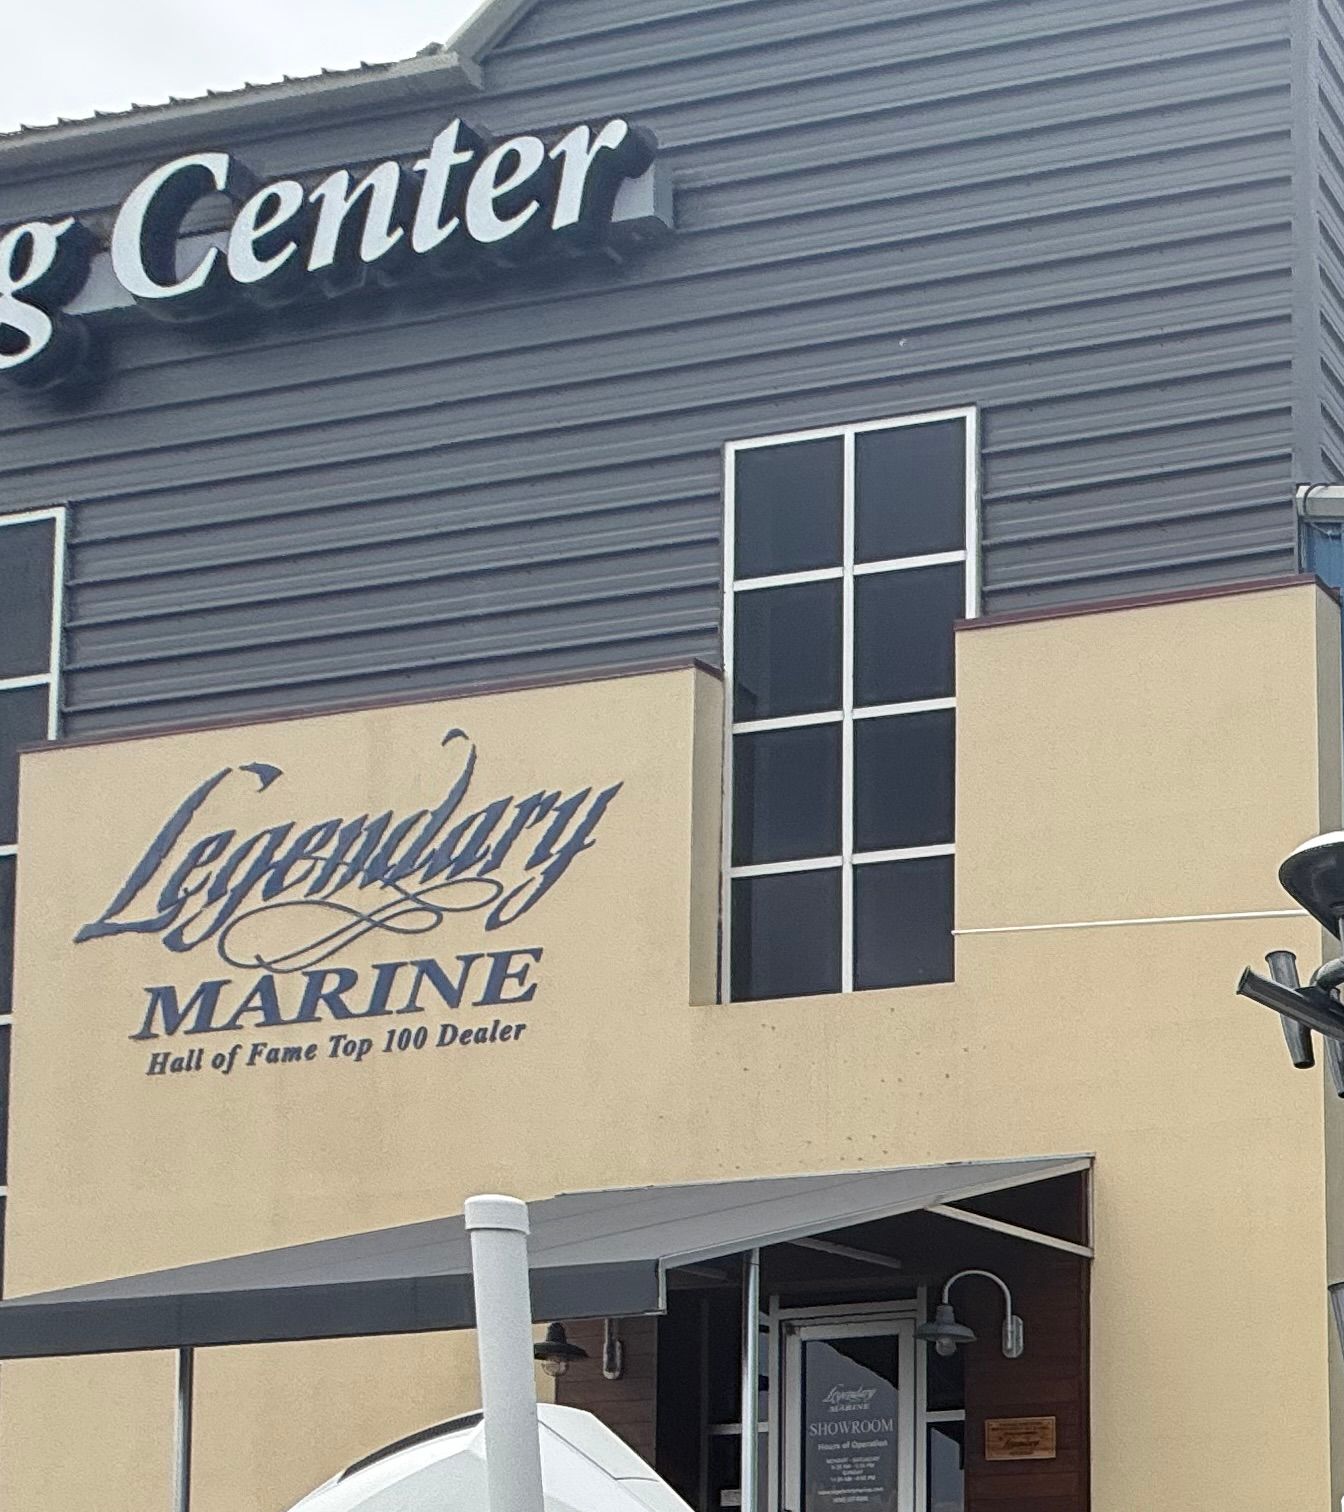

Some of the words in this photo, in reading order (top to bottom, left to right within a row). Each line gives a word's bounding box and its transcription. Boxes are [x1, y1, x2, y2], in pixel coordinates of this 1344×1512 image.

[110, 117, 628, 300] Center
[73, 728, 625, 953] Legendary
[128, 946, 545, 1041] MARINE
[146, 1048, 202, 1076] Hall
[211, 1044, 243, 1075] of
[246, 1041, 318, 1067] Fame
[328, 1034, 373, 1062] Top
[382, 1026, 429, 1053] 100
[436, 1020, 527, 1048] Dealer
[809, 1418, 894, 1436] SHOWROOM
